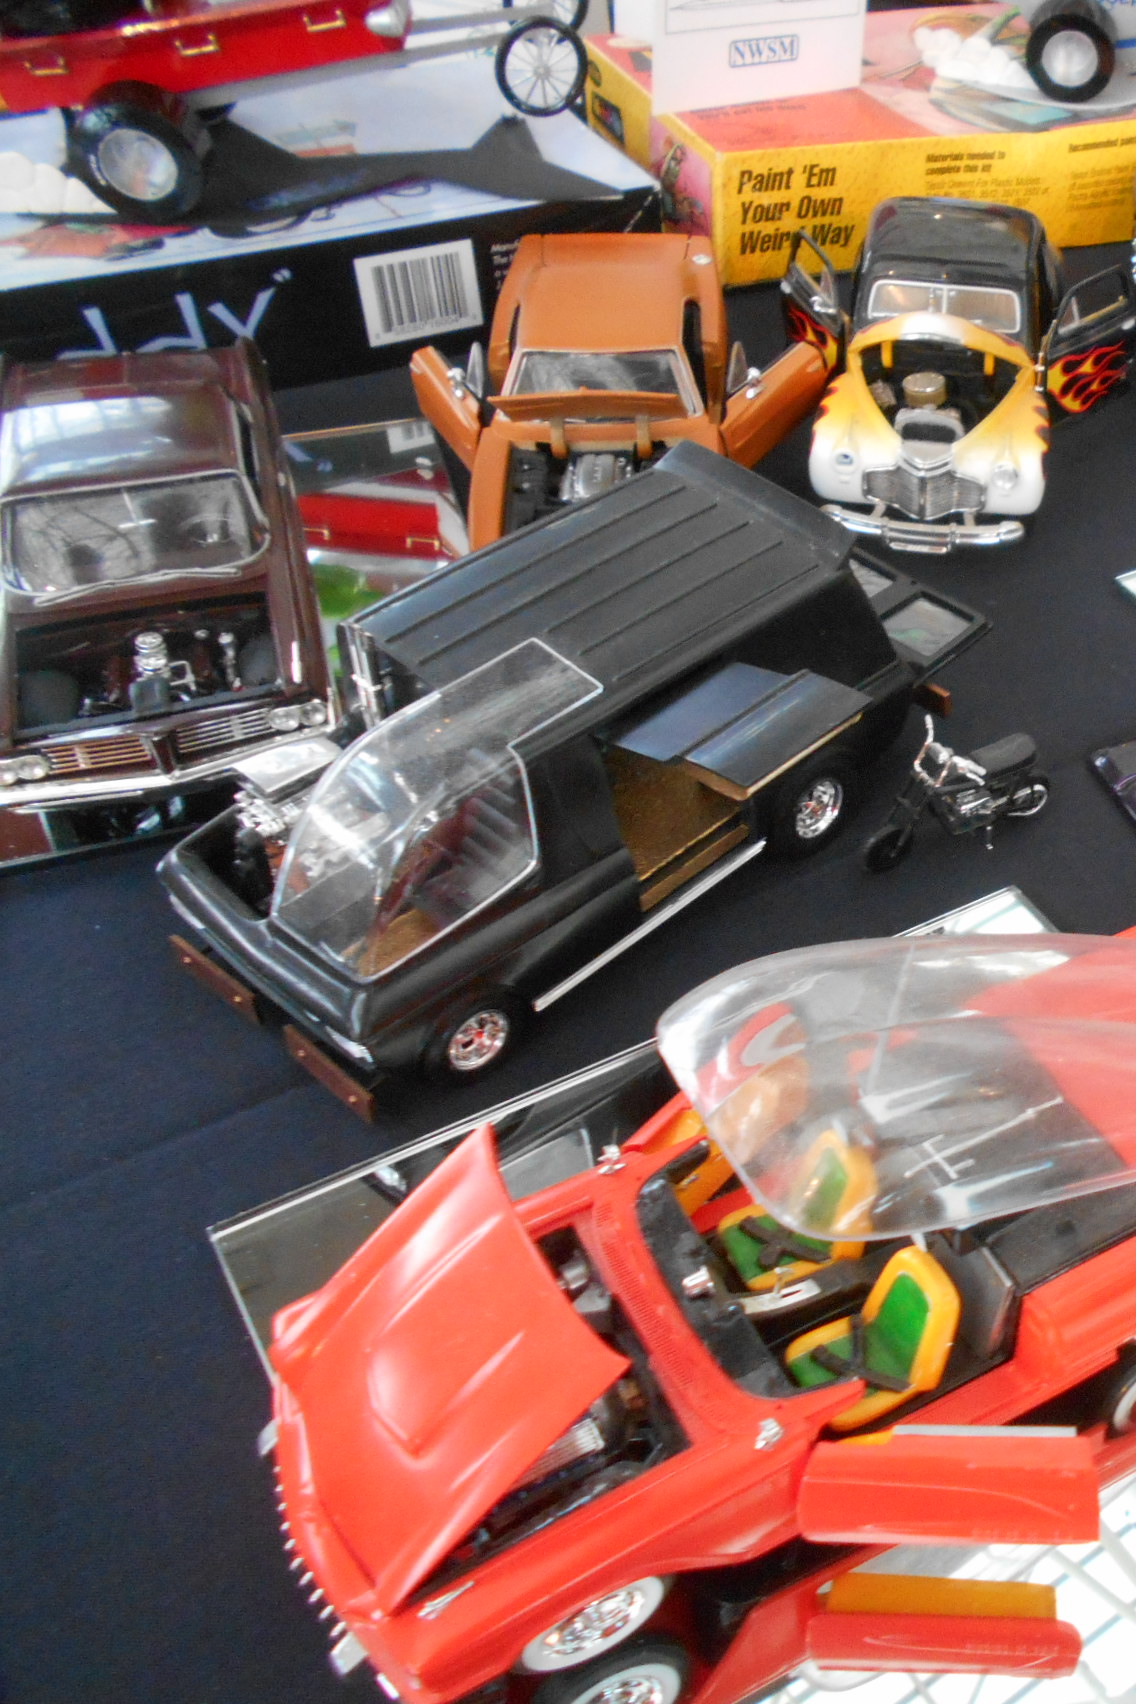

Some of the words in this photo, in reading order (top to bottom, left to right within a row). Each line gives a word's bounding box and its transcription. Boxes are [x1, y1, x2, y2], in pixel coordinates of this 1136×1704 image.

[732, 36, 797, 64] NWSM
[737, 167, 795, 195] Paint
[802, 164, 837, 188] 'Em
[741, 201, 791, 225] Your
[797, 195, 844, 219] Own
[812, 223, 856, 248] Way
